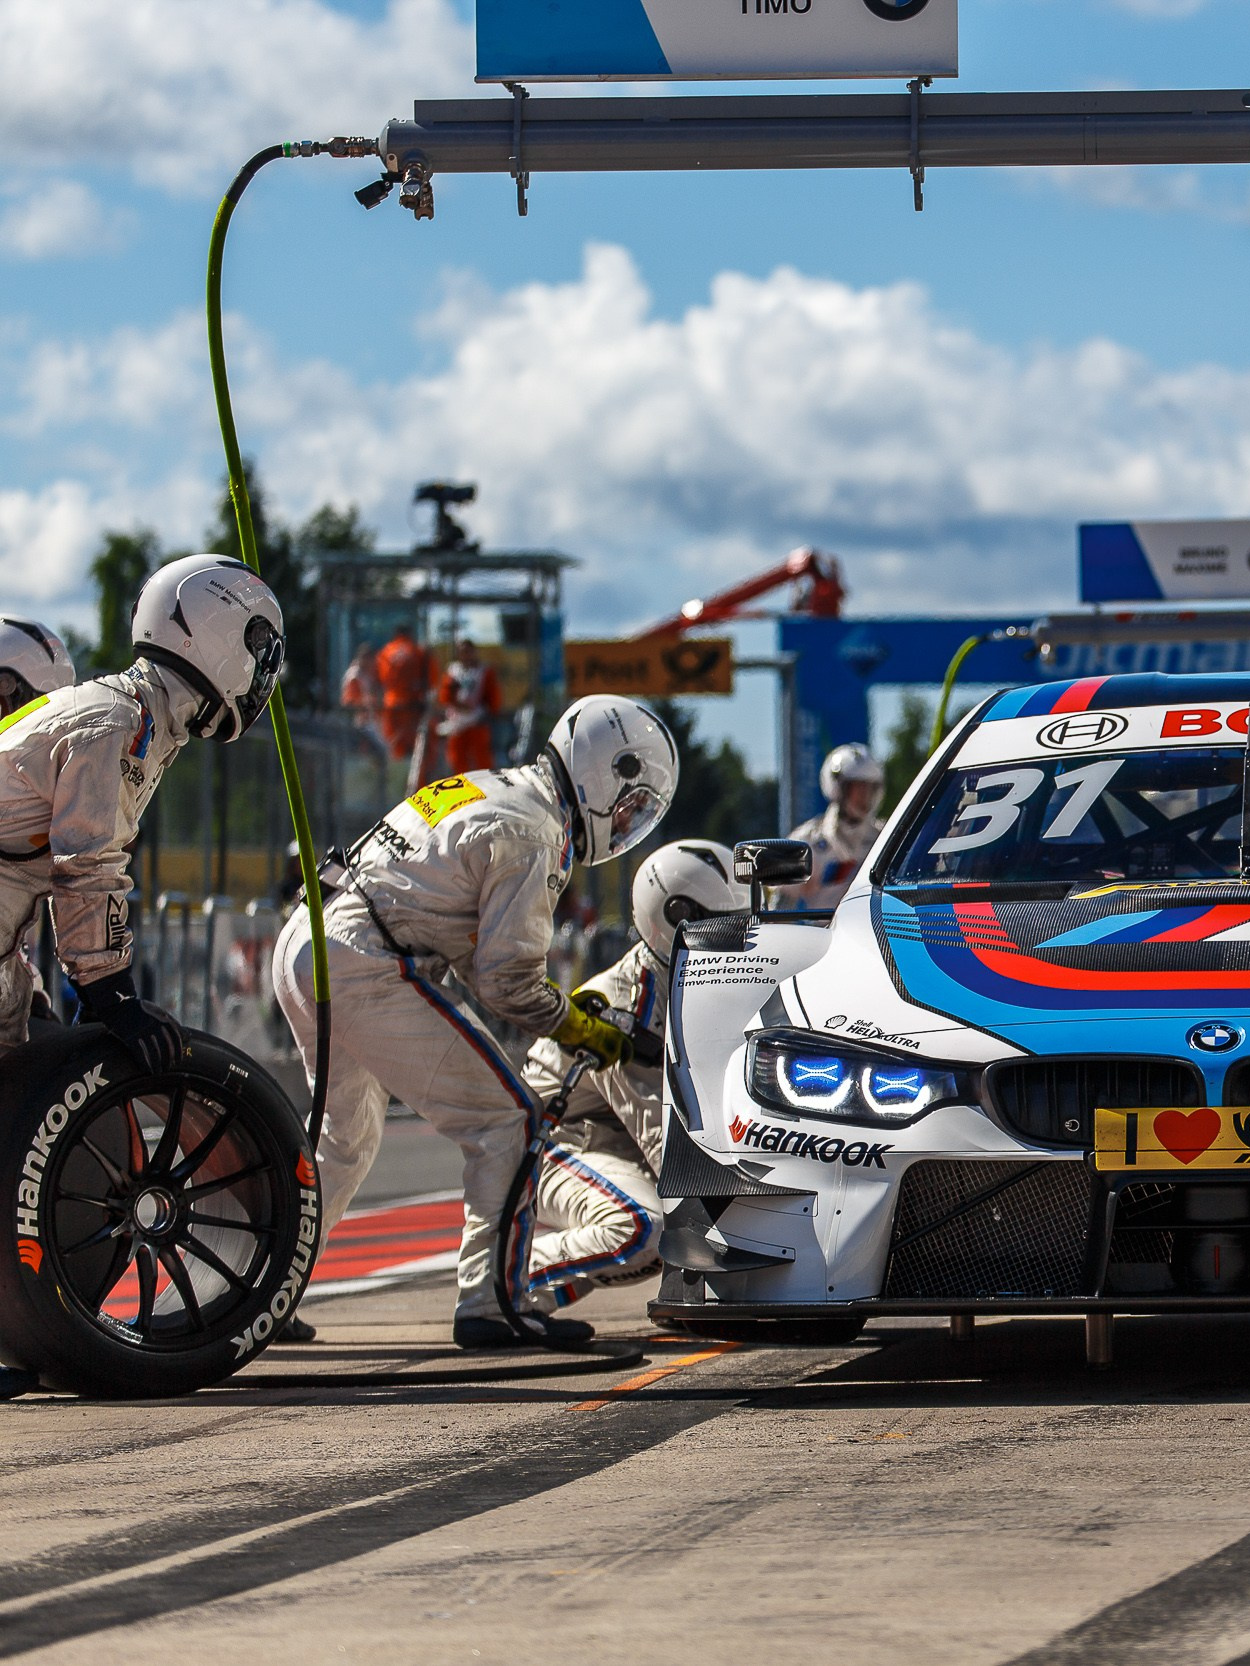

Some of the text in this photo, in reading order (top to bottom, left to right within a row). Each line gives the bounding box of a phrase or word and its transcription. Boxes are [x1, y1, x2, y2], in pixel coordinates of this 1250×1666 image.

[741, 0, 812, 14] TIMO
[928, 759, 1126, 854] 31
[681, 955, 780, 968] BMW Driving
[678, 965, 764, 978] Experience
[677, 976, 777, 988] bmw-m.com/bde
[854, 1019, 874, 1028] Shell
[846, 1024, 921, 1050] HELIX ULTRA
[1124, 1112, 1138, 1166] I
